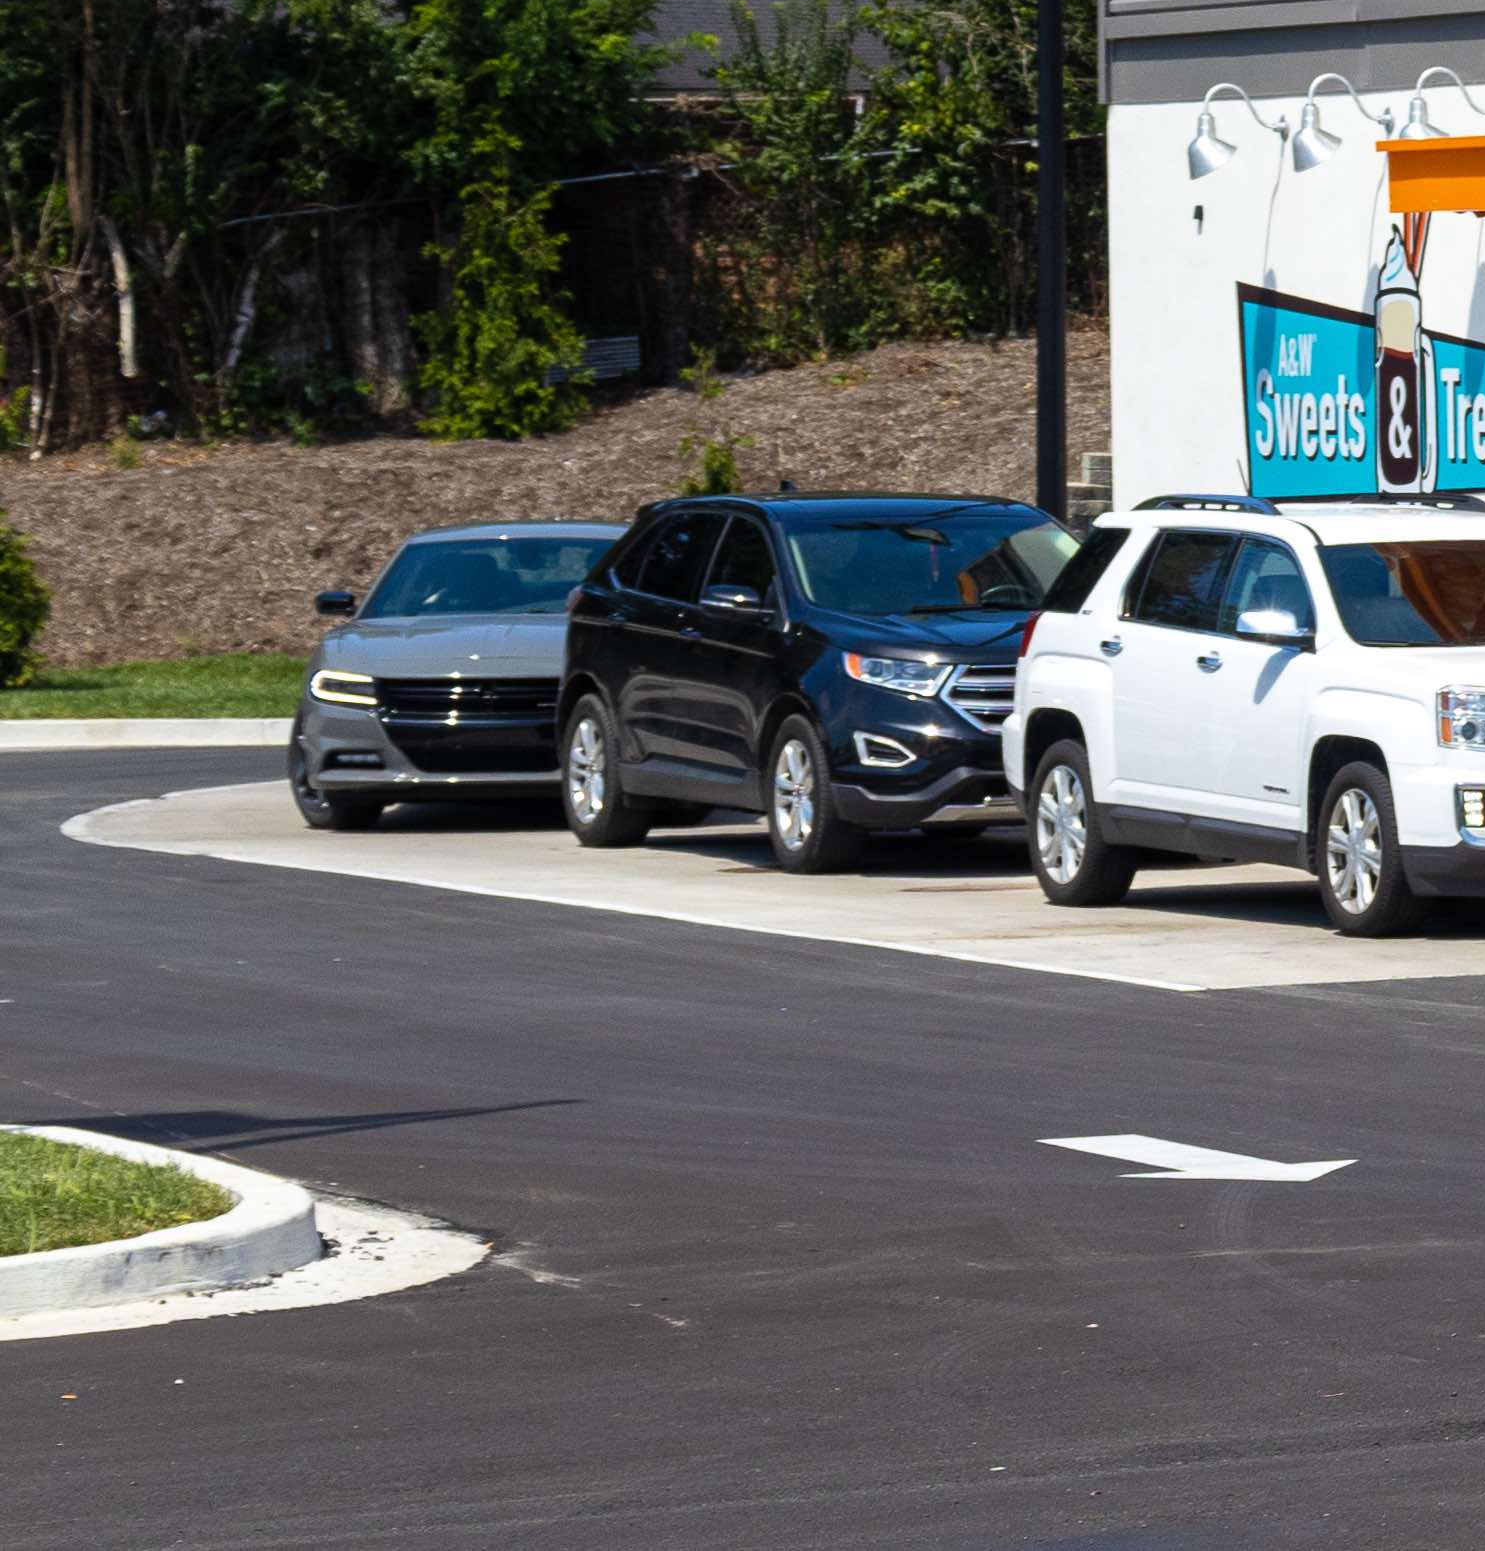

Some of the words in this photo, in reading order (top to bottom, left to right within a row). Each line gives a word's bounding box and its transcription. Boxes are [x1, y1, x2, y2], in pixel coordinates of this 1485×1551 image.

[1278, 334, 1315, 377] A&W
[1255, 368, 1367, 460] Sweets
[1388, 375, 1414, 459] &
